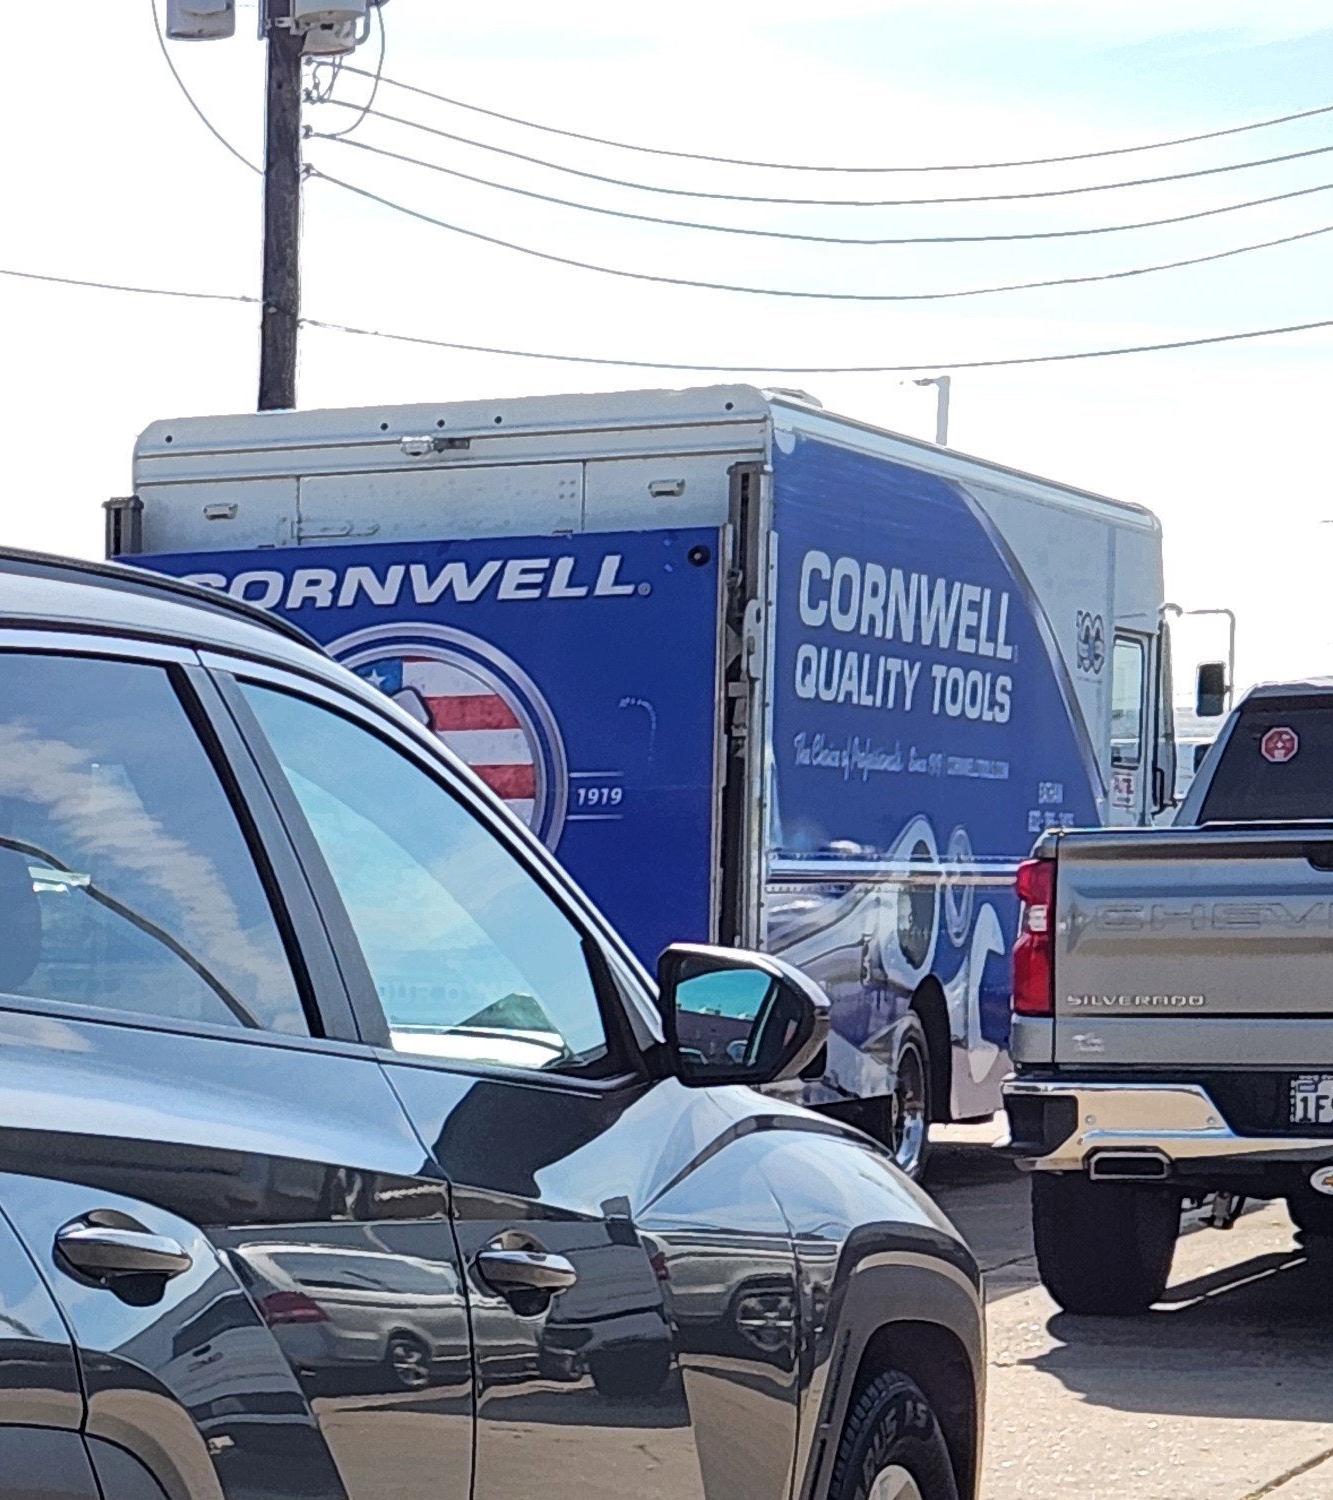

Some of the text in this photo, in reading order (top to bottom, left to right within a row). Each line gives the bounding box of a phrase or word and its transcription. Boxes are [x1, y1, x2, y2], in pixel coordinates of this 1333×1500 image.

[799, 549, 1014, 661] CORNWELL
[794, 643, 1013, 724] QUALITY TOOLS
[576, 786, 624, 806] 1919
[1096, 902, 1333, 932] CHEV
[1066, 994, 1206, 1008] SILVERADO
[1298, 1094, 1333, 1123] 1F
